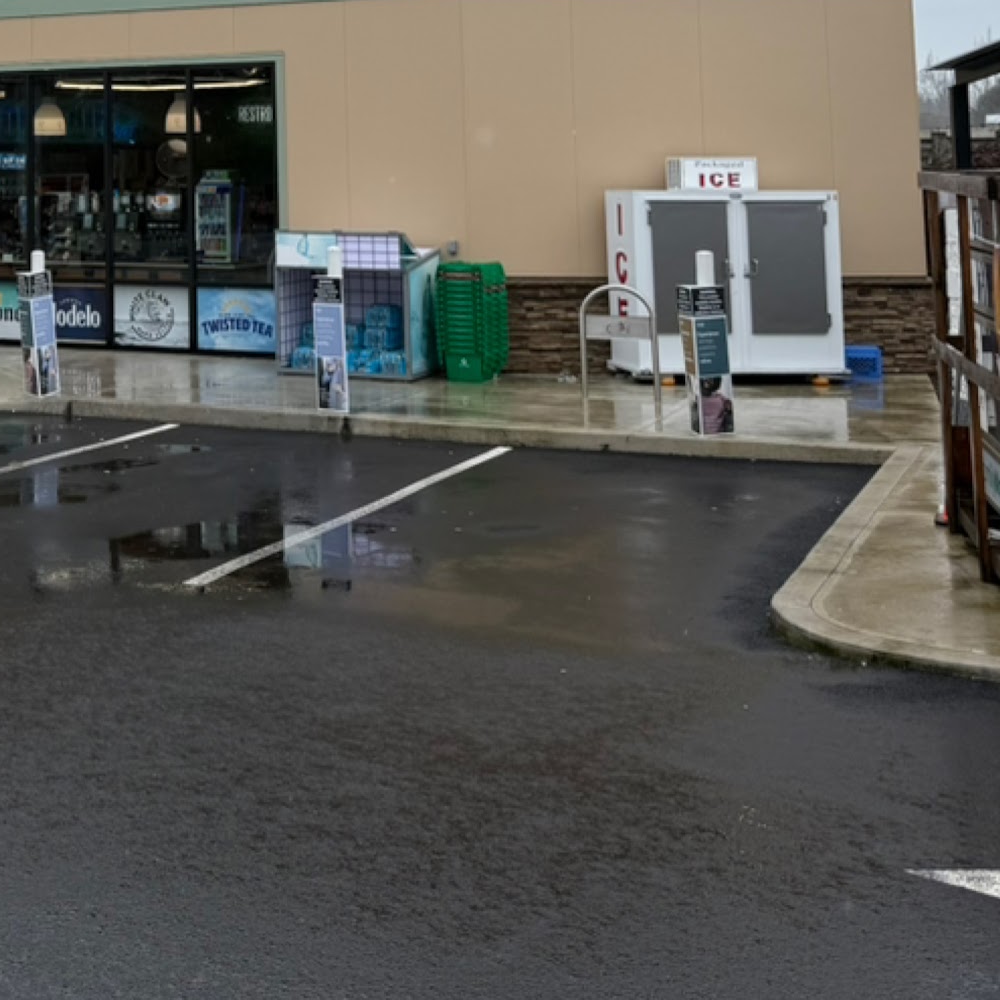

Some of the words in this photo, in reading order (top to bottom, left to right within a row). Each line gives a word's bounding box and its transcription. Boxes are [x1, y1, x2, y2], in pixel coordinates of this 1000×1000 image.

[698, 172, 742, 188] ICE
[56, 304, 101, 328] odelo
[201, 317, 251, 336] TWISTED
[252, 319, 274, 338] TEA
